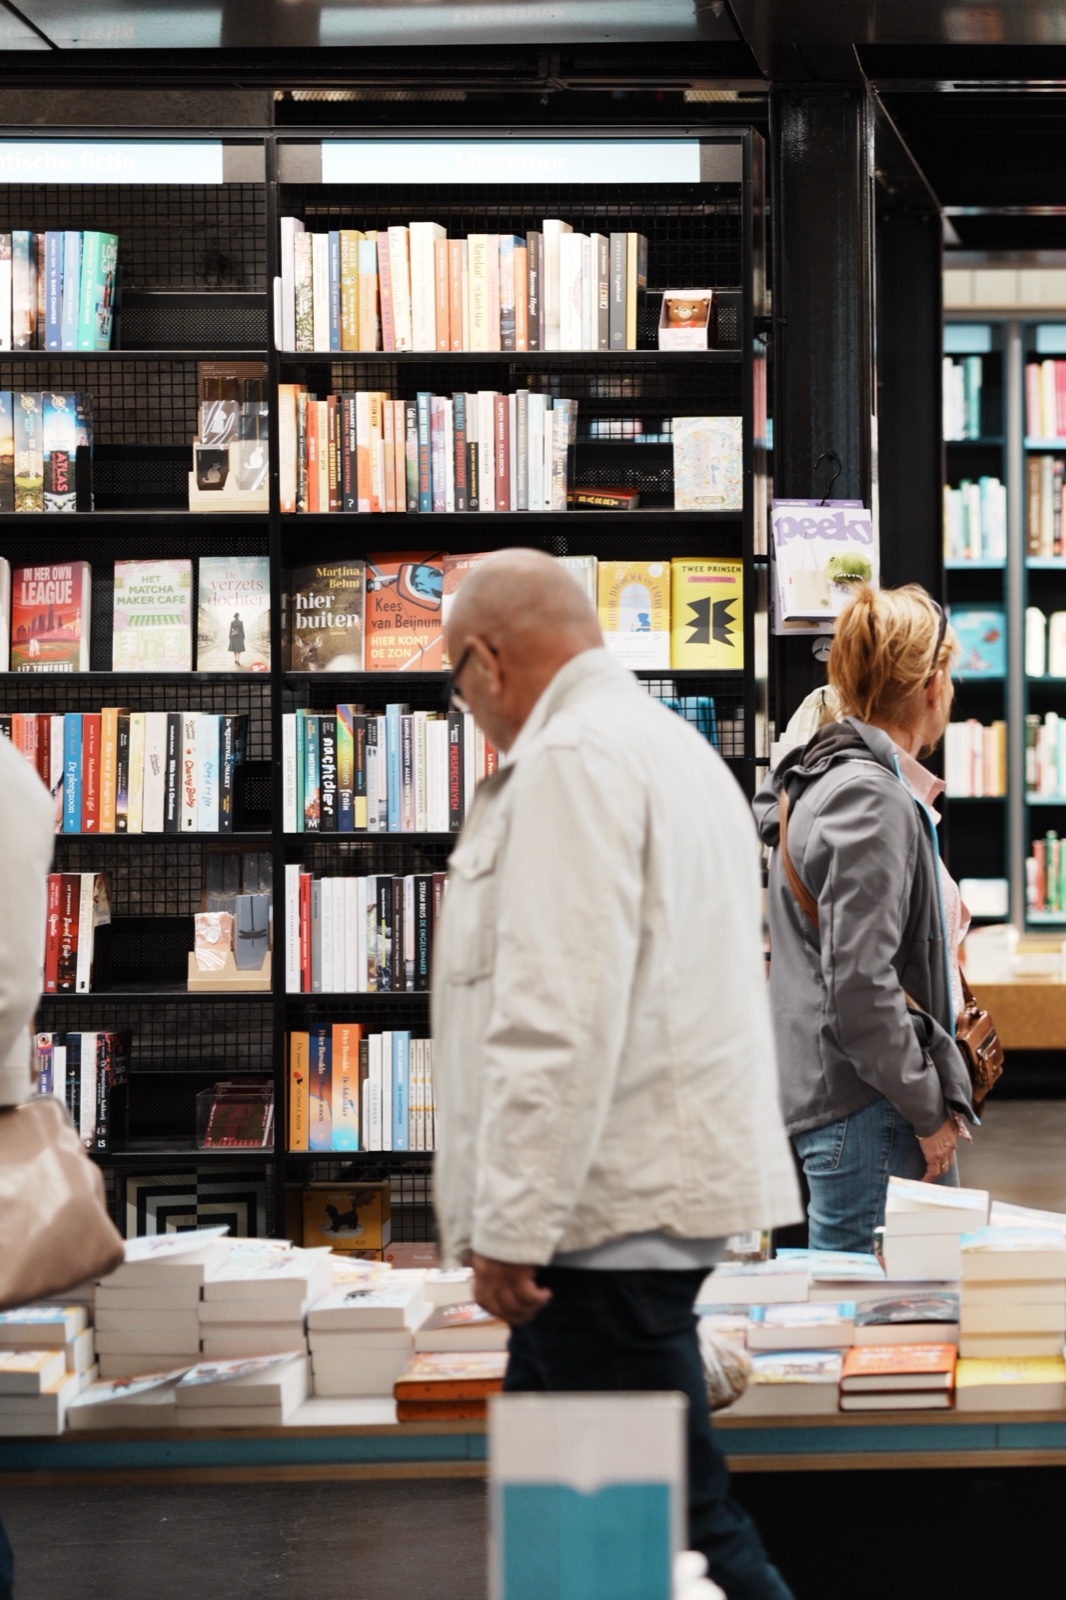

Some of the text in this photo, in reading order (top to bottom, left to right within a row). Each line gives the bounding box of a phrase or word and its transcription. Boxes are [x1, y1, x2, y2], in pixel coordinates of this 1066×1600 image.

[80, 150, 136, 172] fictie
[341, 235, 349, 274] ABDOLAH
[349, 241, 357, 268] KADER
[473, 243, 485, 279] Martelaar!
[528, 270, 537, 316] Mevrouw Hayat
[474, 293, 483, 329] Kaveh Akbar
[419, 396, 428, 408] ANNE
[455, 395, 465, 413] ERDAL
[420, 409, 428, 424] MIEKE
[518, 398, 526, 452] JULIAN BARNES
[29, 439, 36, 449] DE
[420, 425, 428, 445] BACKER
[19, 450, 29, 469] ZUS
[329, 443, 337, 490] CONFRONTATIES
[456, 440, 465, 489] WEDERGEBOORTE
[56, 453, 69, 492] ATLAS
[578, 496, 620, 506] BARRY
[774, 511, 874, 547] peeky
[23, 566, 72, 582] IN HER OWN
[225, 571, 237, 579] De
[316, 566, 360, 577] Martina
[682, 565, 742, 573] TWEE PRINSEN
[141, 575, 162, 583] HET
[211, 580, 264, 591] verzets
[329, 579, 360, 589] Behm
[21, 580, 73, 606] LEAGUE
[129, 585, 174, 594] MATCHA
[117, 594, 186, 605] MAKER CAFÉ
[208, 592, 264, 606] dochter
[295, 592, 336, 610] hier
[375, 597, 403, 612] Kees
[295, 611, 360, 630] buiten
[371, 614, 441, 631] van Beijnum
[371, 635, 429, 646] HIER KOMT
[371, 648, 412, 659] DE ZON
[33, 664, 74, 672] TOMFORDE
[224, 718, 232, 761] De REGENVAL
[105, 741, 113, 758] Alles
[488, 753, 493, 761] La
[68, 761, 77, 772] De
[286, 756, 294, 772] Land
[342, 760, 351, 785] bellen
[184, 760, 197, 808] Cherry Baby
[322, 738, 336, 815] nachtdier
[451, 745, 460, 810] PERSPECTIEVEN
[66, 773, 77, 813] pleegzoon
[103, 780, 112, 803] dragen
[286, 787, 294, 807] Johan
[339, 789, 352, 811] fenix
[87, 797, 95, 811] Eiffel
[81, 902, 87, 913] we
[323, 895, 332, 914] John
[323, 916, 332, 939] Boyne
[418, 881, 427, 975] STEFAN DE ENGELENMAKER
[341, 1029, 350, 1045] Peter
[297, 1042, 303, 1051] De
[82, 1080, 90, 1100] VAN
[97, 1139, 106, 1147] LS
